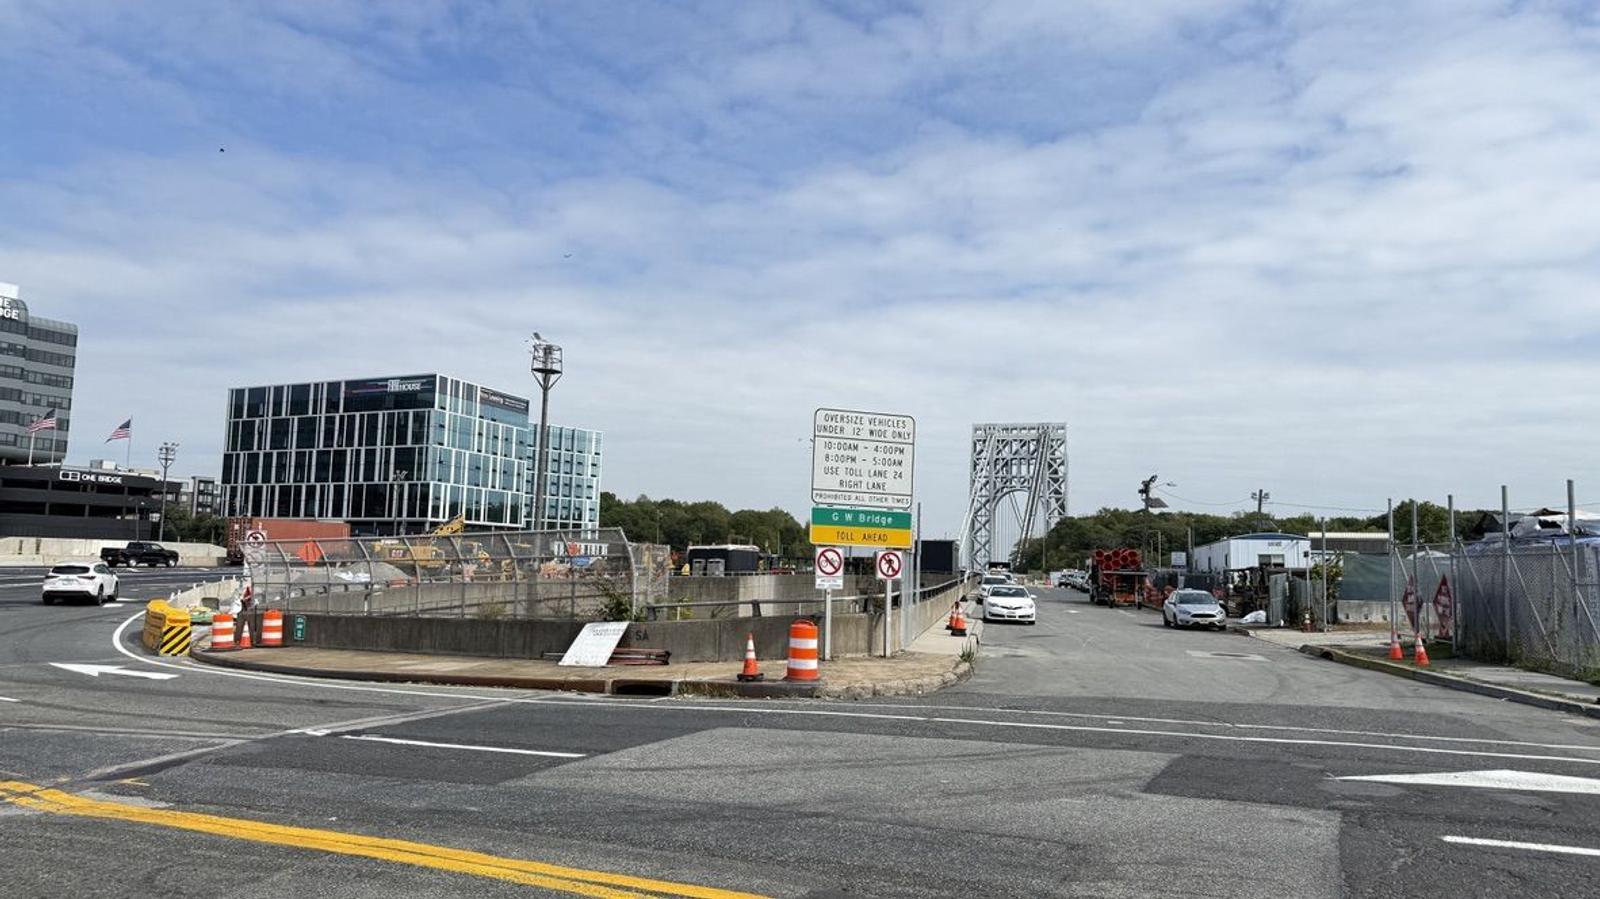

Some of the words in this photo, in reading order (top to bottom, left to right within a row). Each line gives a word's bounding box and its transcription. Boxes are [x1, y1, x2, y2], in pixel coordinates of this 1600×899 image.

[824, 413, 864, 425] OVERSIZE
[868, 417, 907, 429] VEHICLES
[816, 424, 845, 434] UNDER
[869, 429, 887, 438] WIDE
[891, 430, 911, 440] ONLY
[824, 441, 859, 451] 10:00AM
[873, 445, 905, 455] 4:00PM
[824, 454, 857, 463] 8:00PM
[872, 457, 903, 467] 5:00AM
[81, 474, 97, 482] ONE
[98, 475, 122, 484] BRIDGE
[823, 466, 840, 476] USE
[845, 467, 863, 477] TOLL
[867, 470, 888, 479] LANE
[893, 471, 903, 479] 24
[839, 480, 863, 489] RIGHT
[866, 482, 887, 491] LANE
[815, 493, 851, 501] PROHIBITED
[832, 512, 839, 521] G
[845, 512, 853, 521] W
[860, 513, 893, 526] Bridge
[836, 531, 854, 541] TOLL
[862, 533, 888, 542] AHEAD
